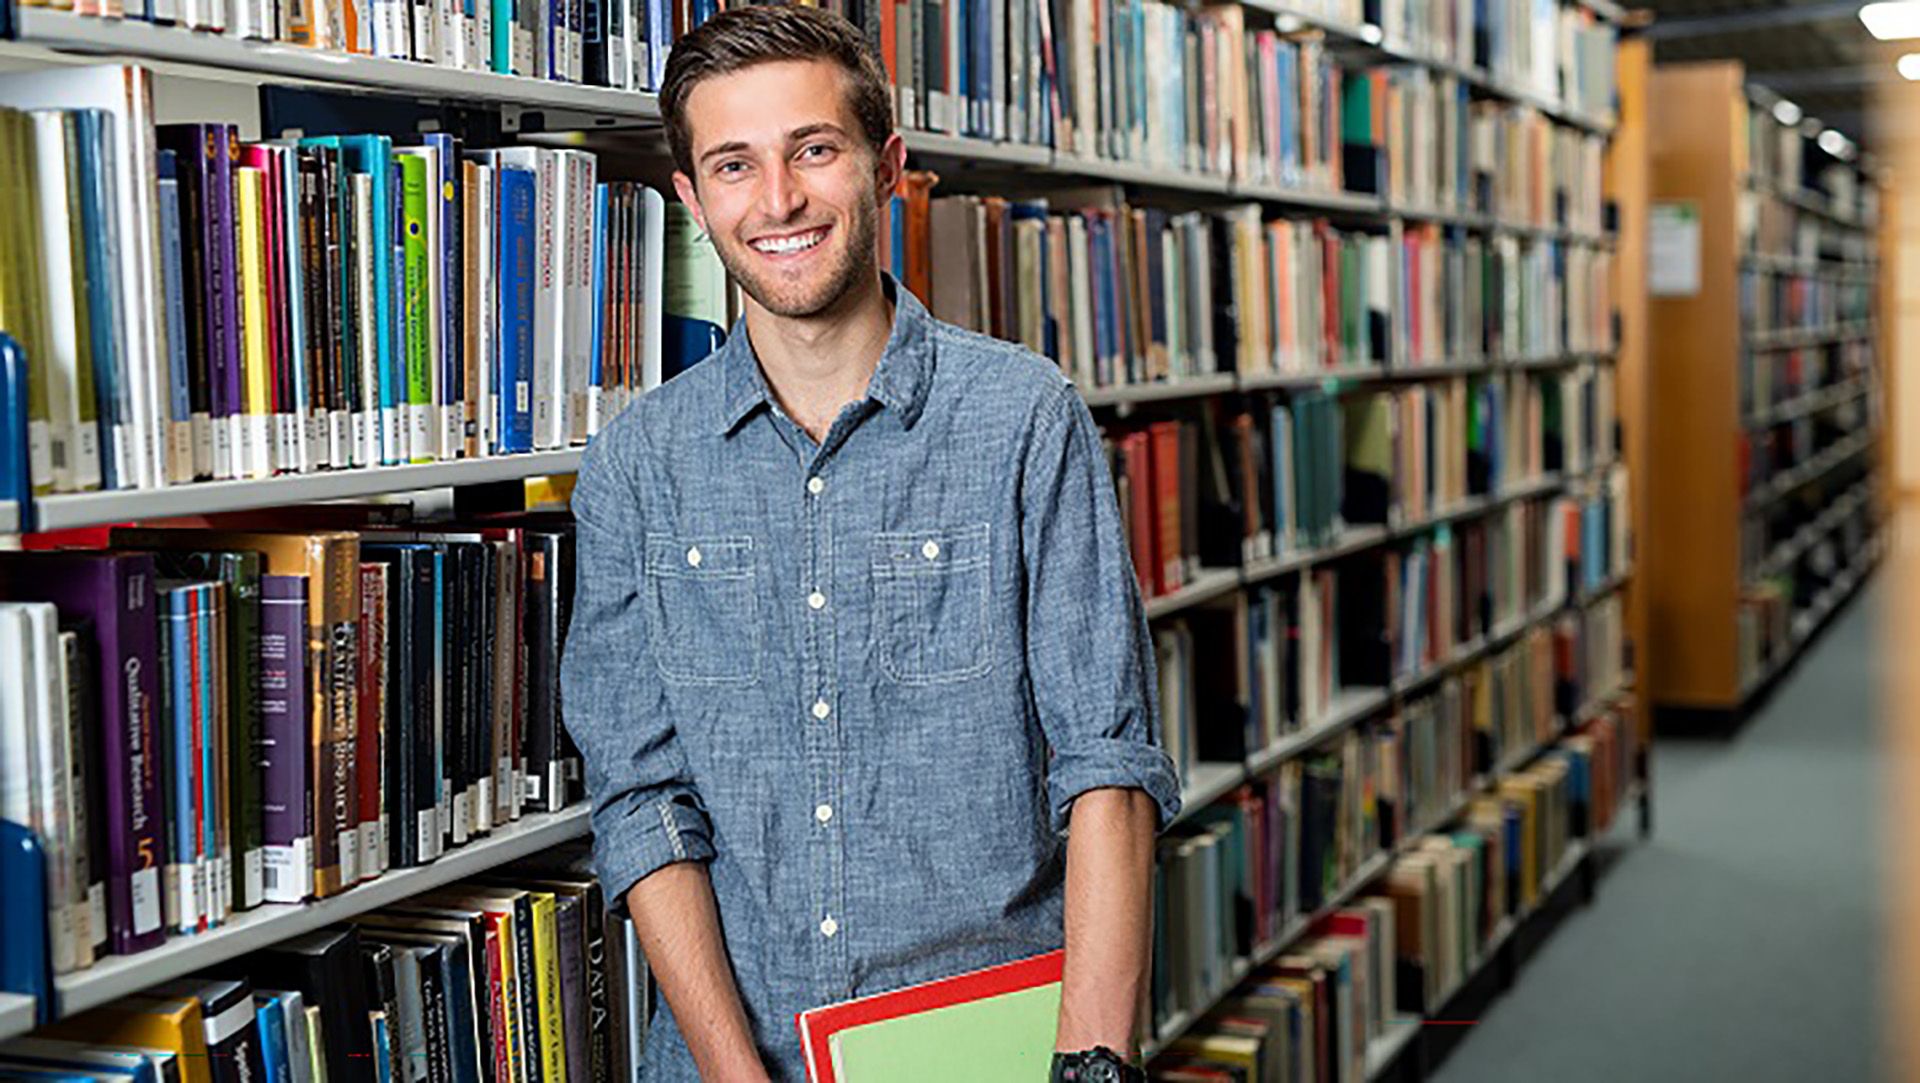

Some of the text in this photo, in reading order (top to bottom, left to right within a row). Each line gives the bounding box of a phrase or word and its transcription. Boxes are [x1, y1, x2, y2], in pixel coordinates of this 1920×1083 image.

[209, 173, 219, 220] Research
[211, 223, 222, 271] Methods
[213, 273, 223, 290] for
[214, 293, 224, 326] Social
[331, 626, 349, 831] QUALITATIVE RESEARCH
[124, 657, 154, 870] Qualitative Research 5
[588, 936, 607, 1030] DATA
